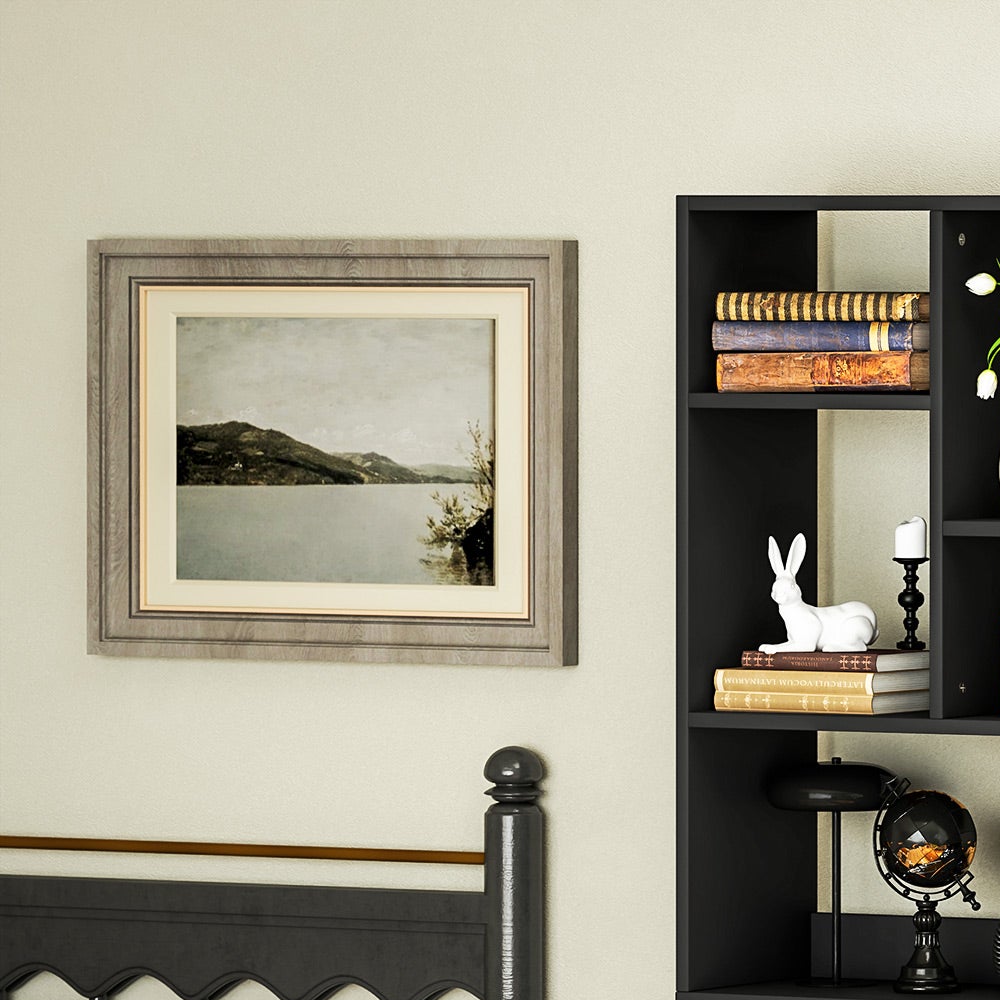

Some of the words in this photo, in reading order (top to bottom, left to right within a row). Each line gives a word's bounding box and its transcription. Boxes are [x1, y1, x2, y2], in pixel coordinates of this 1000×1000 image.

[724, 677, 777, 686] LATINARUM
[778, 679, 813, 687] VOCUM
[815, 680, 864, 689] LATERCULI
